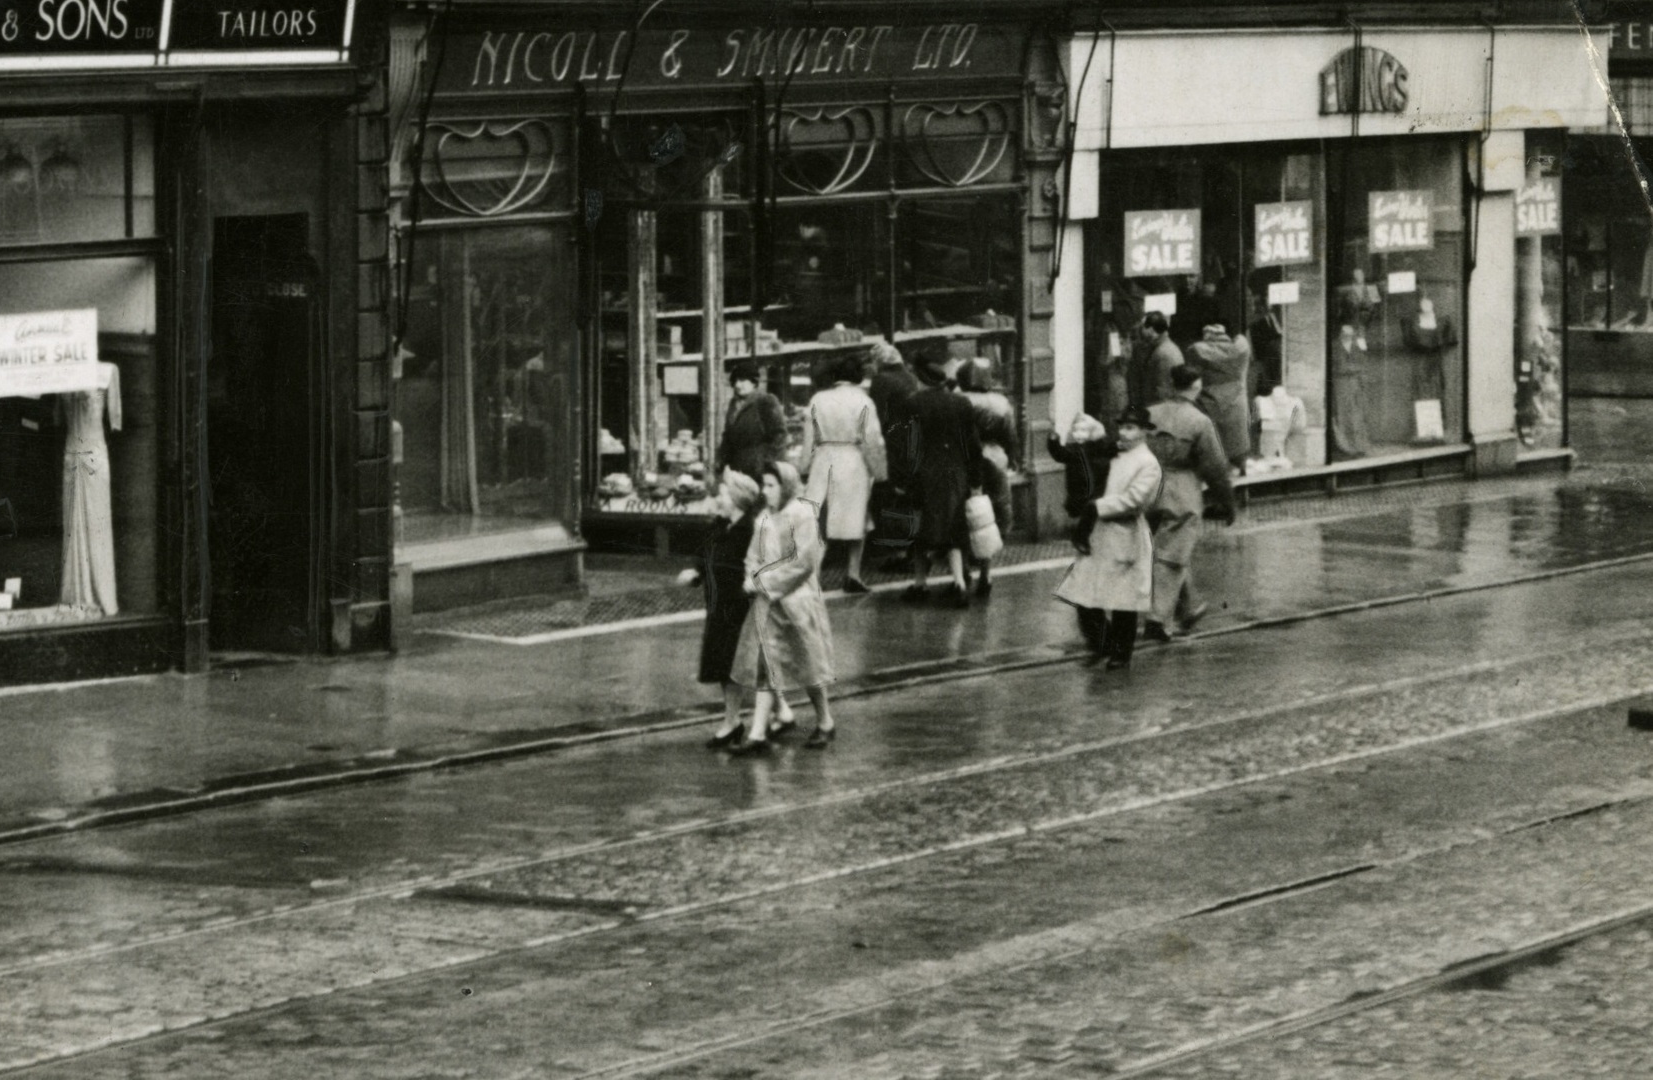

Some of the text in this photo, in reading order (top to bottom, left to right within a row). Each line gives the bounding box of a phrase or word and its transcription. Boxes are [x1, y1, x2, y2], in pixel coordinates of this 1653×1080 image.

[0, 10, 20, 42] &
[216, 9, 318, 37] TAILORS
[471, 30, 628, 86] NICOLL
[660, 28, 691, 79] &
[1516, 196, 1557, 232] SALE
[1259, 230, 1310, 263] SALE
[1373, 221, 1429, 249] SALE
[1131, 238, 1194, 272] SALE
[0, 342, 88, 366] WINTER SALE
